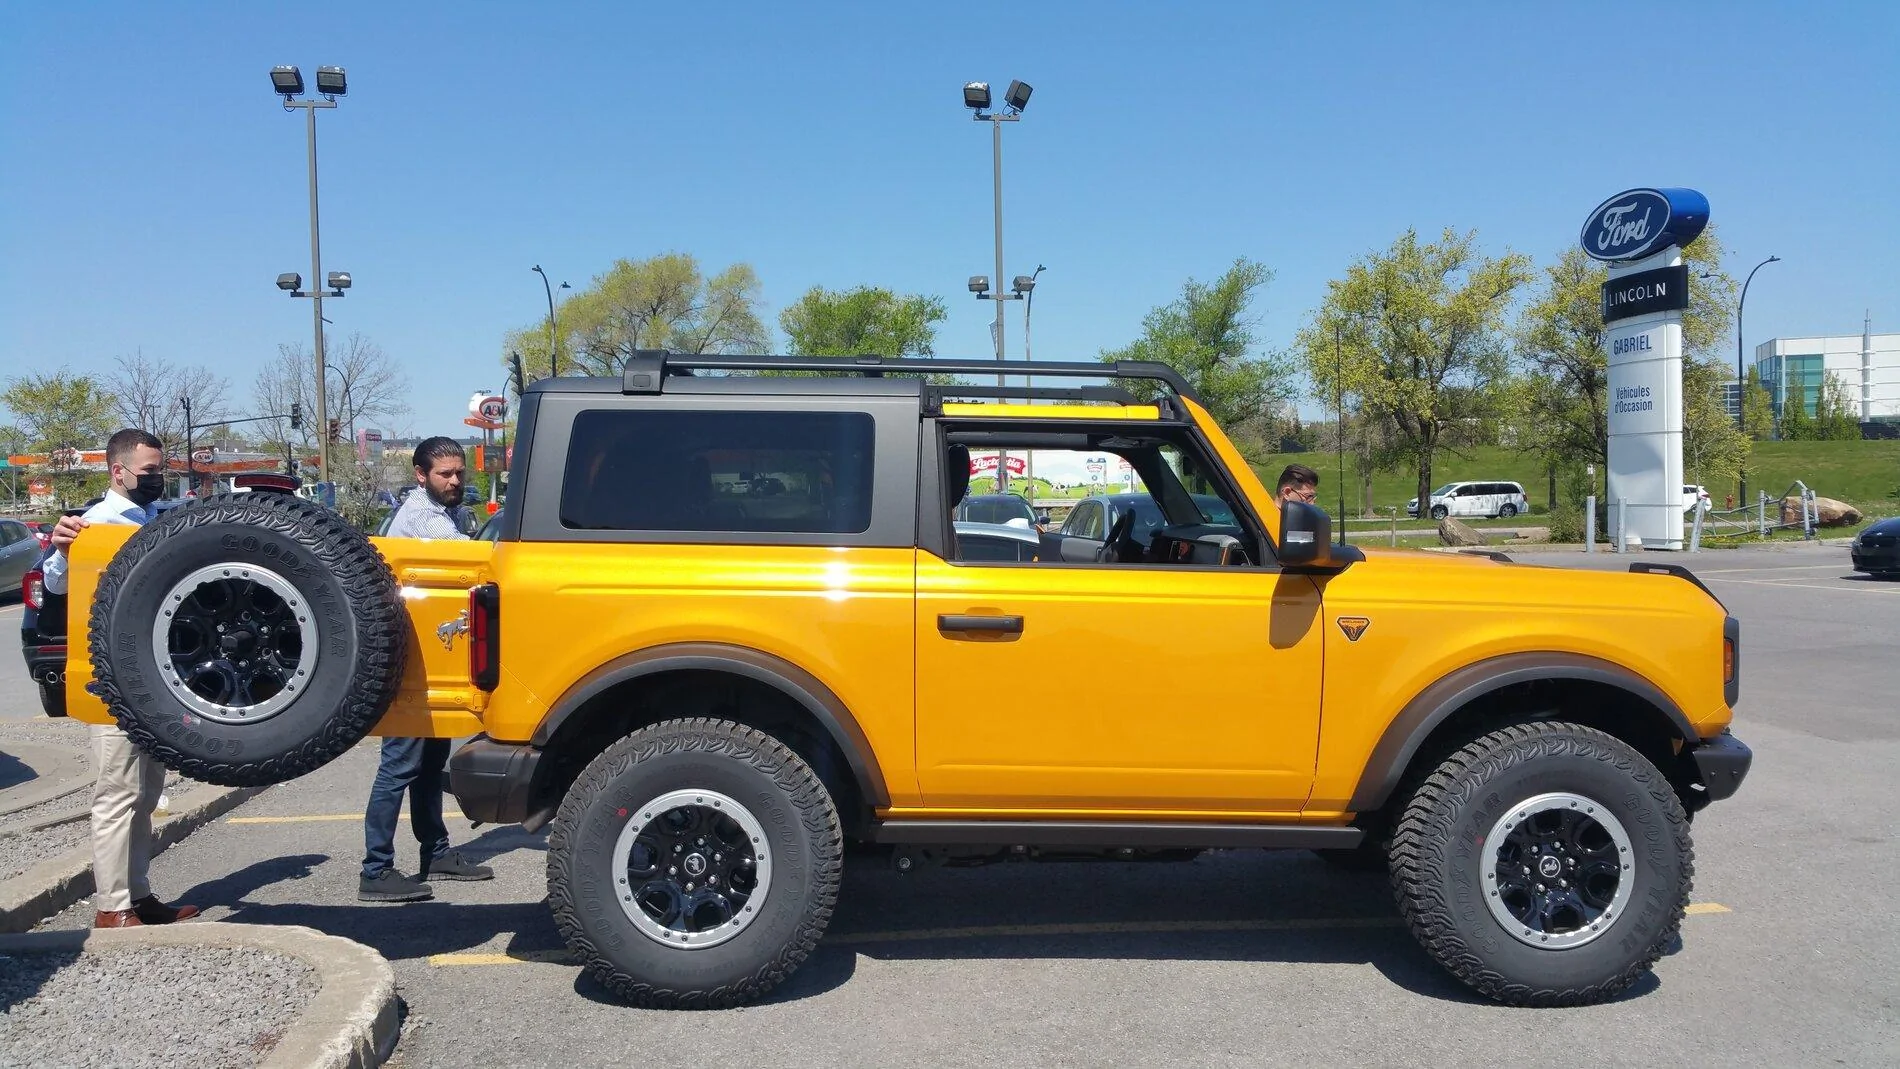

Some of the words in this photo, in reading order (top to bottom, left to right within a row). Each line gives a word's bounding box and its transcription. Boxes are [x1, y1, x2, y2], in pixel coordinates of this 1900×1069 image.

[1598, 202, 1651, 250] Ford
[1609, 282, 1666, 307] LINCOLN
[1613, 334, 1652, 356] GABRIEL
